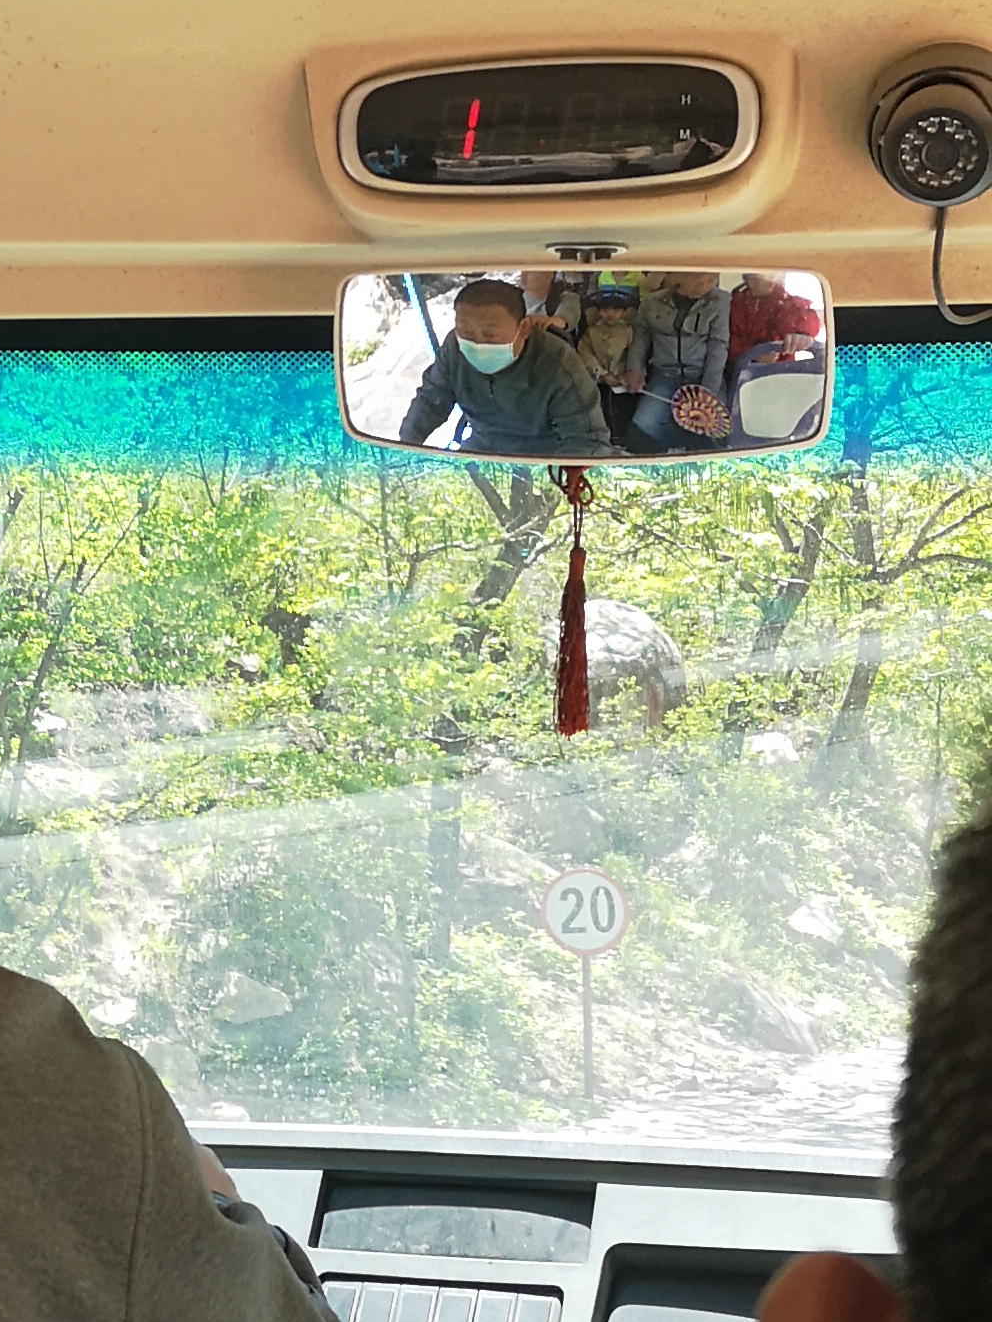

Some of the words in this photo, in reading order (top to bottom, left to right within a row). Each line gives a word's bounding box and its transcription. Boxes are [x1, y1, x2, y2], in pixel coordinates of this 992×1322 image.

[681, 94, 691, 106] H
[679, 128, 691, 139] M
[559, 885, 616, 934] 20
